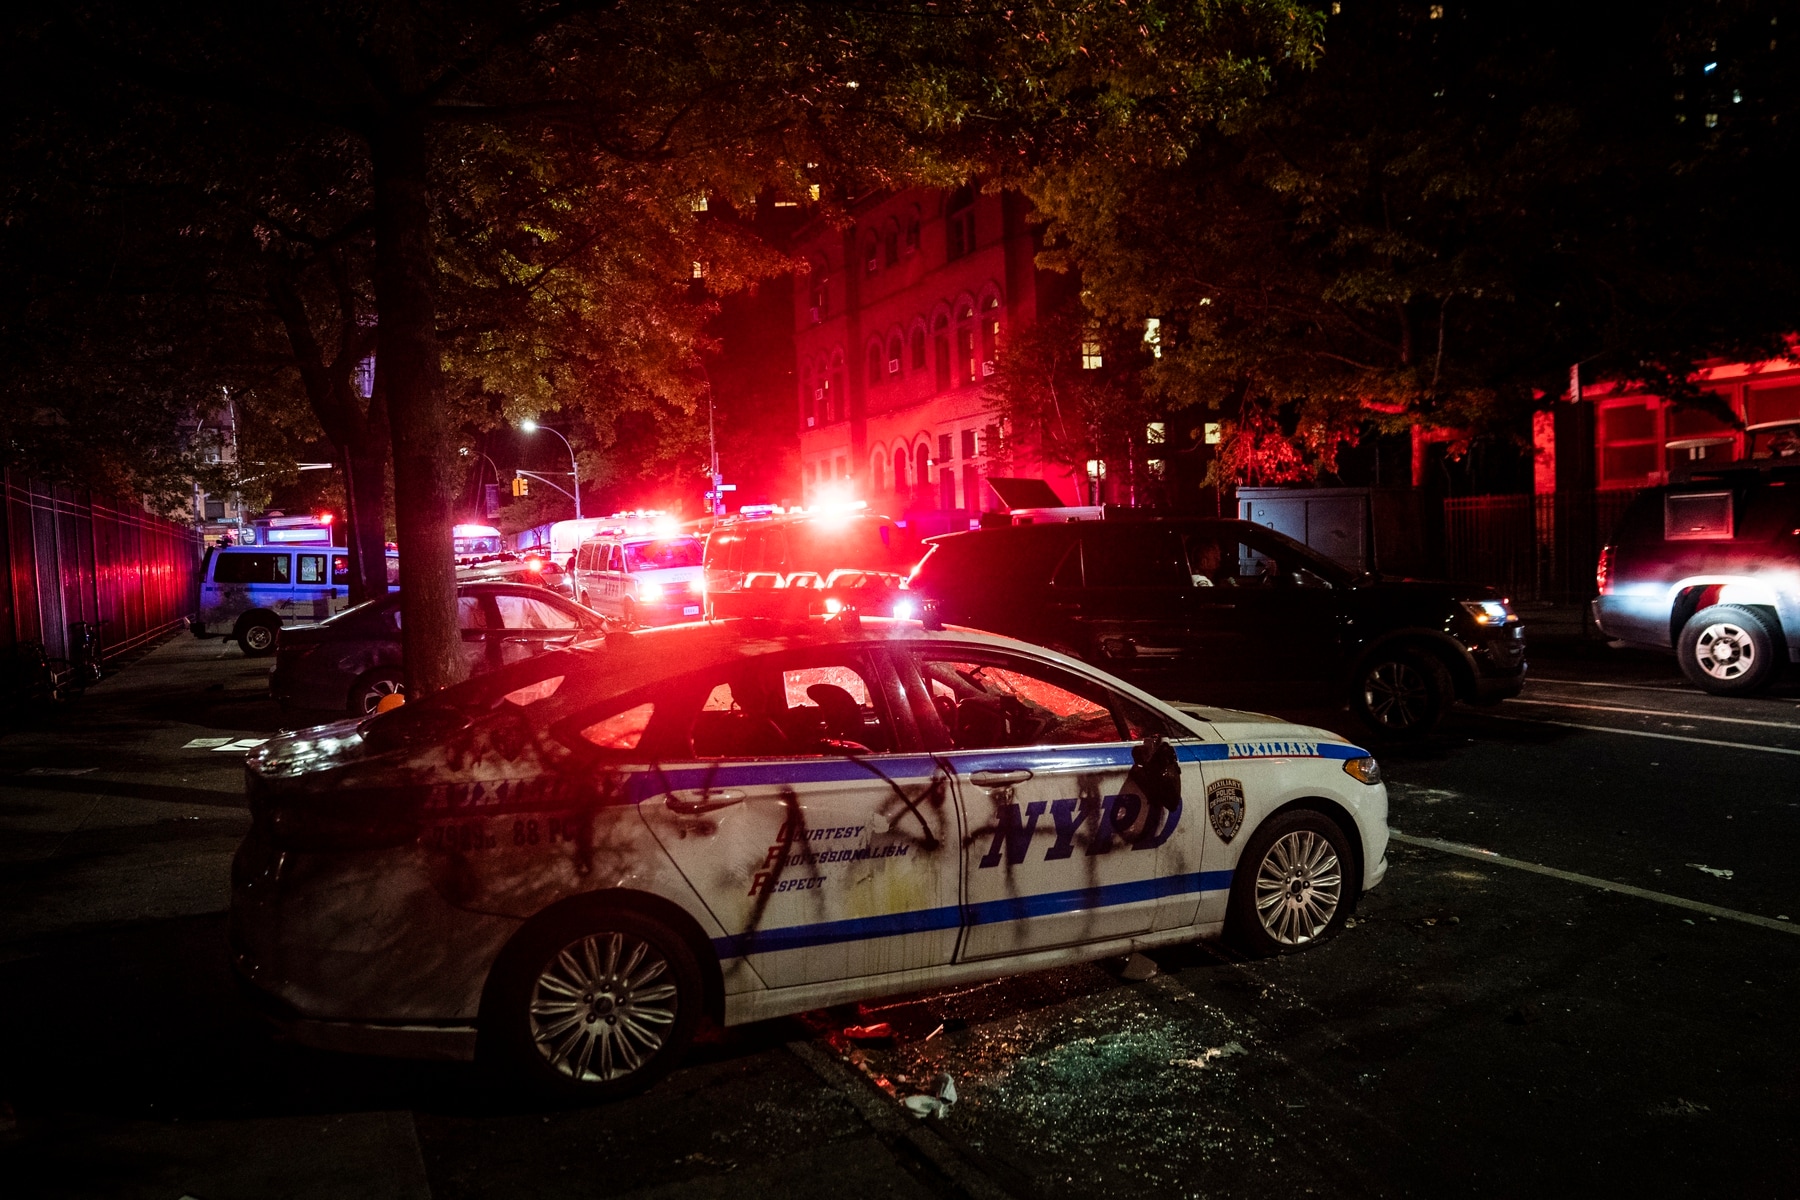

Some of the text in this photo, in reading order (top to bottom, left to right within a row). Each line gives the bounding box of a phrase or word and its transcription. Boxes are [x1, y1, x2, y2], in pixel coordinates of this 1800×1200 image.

[1227, 742, 1320, 756] AUXILIARY
[1208, 779, 1241, 792] AUXILIARY
[1215, 789, 1236, 797] POLICE
[1210, 796, 1243, 808] DEPARTMENT
[1210, 814, 1218, 829] CITY
[512, 819, 539, 846] 88
[978, 793, 1182, 868] NYPD
[1230, 825, 1240, 837] NEW
